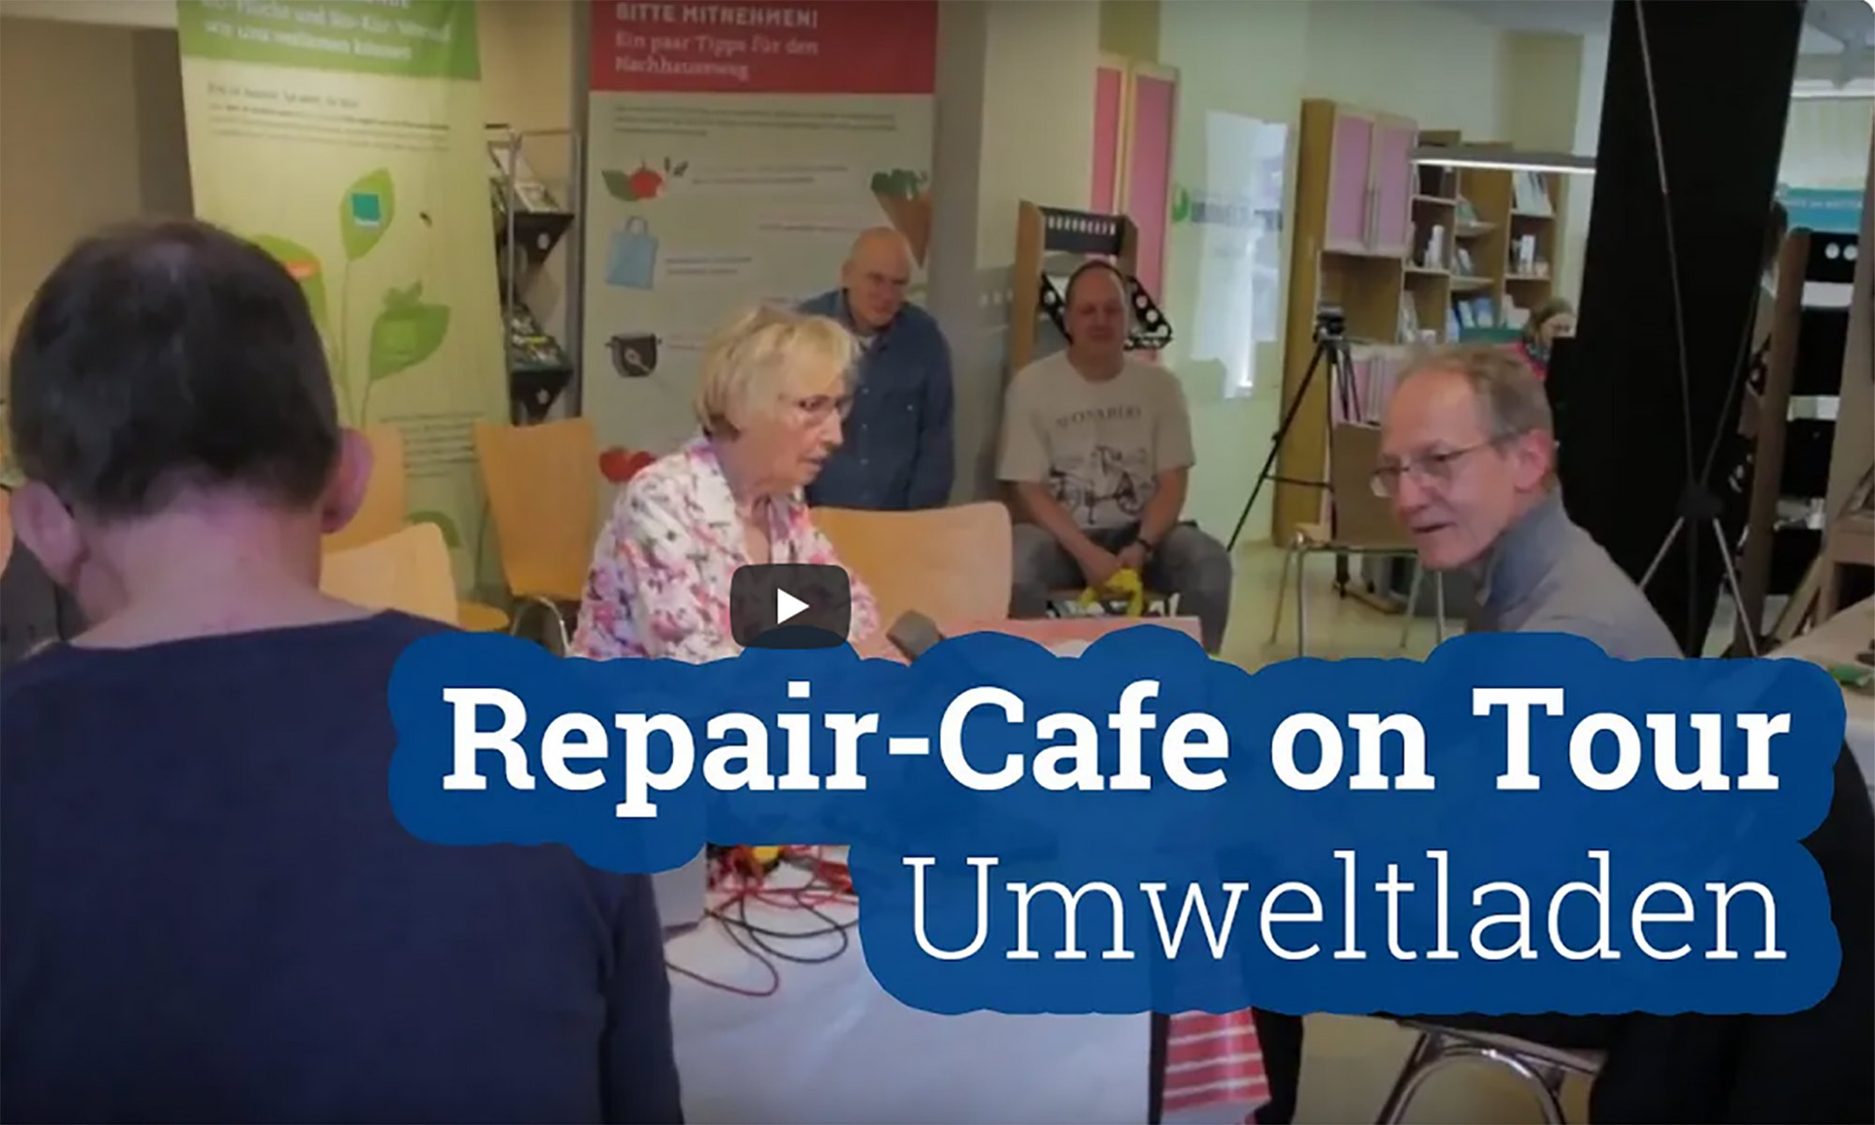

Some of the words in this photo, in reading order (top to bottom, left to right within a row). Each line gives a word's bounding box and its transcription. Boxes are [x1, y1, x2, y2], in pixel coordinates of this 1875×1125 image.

[614, 2, 675, 23] BITTE
[682, 5, 819, 29] MITNEHMEN!
[614, 30, 646, 48] Ein
[650, 35, 691, 54] paar
[693, 34, 748, 58] Tipps
[750, 32, 780, 53] für
[785, 37, 820, 56] den
